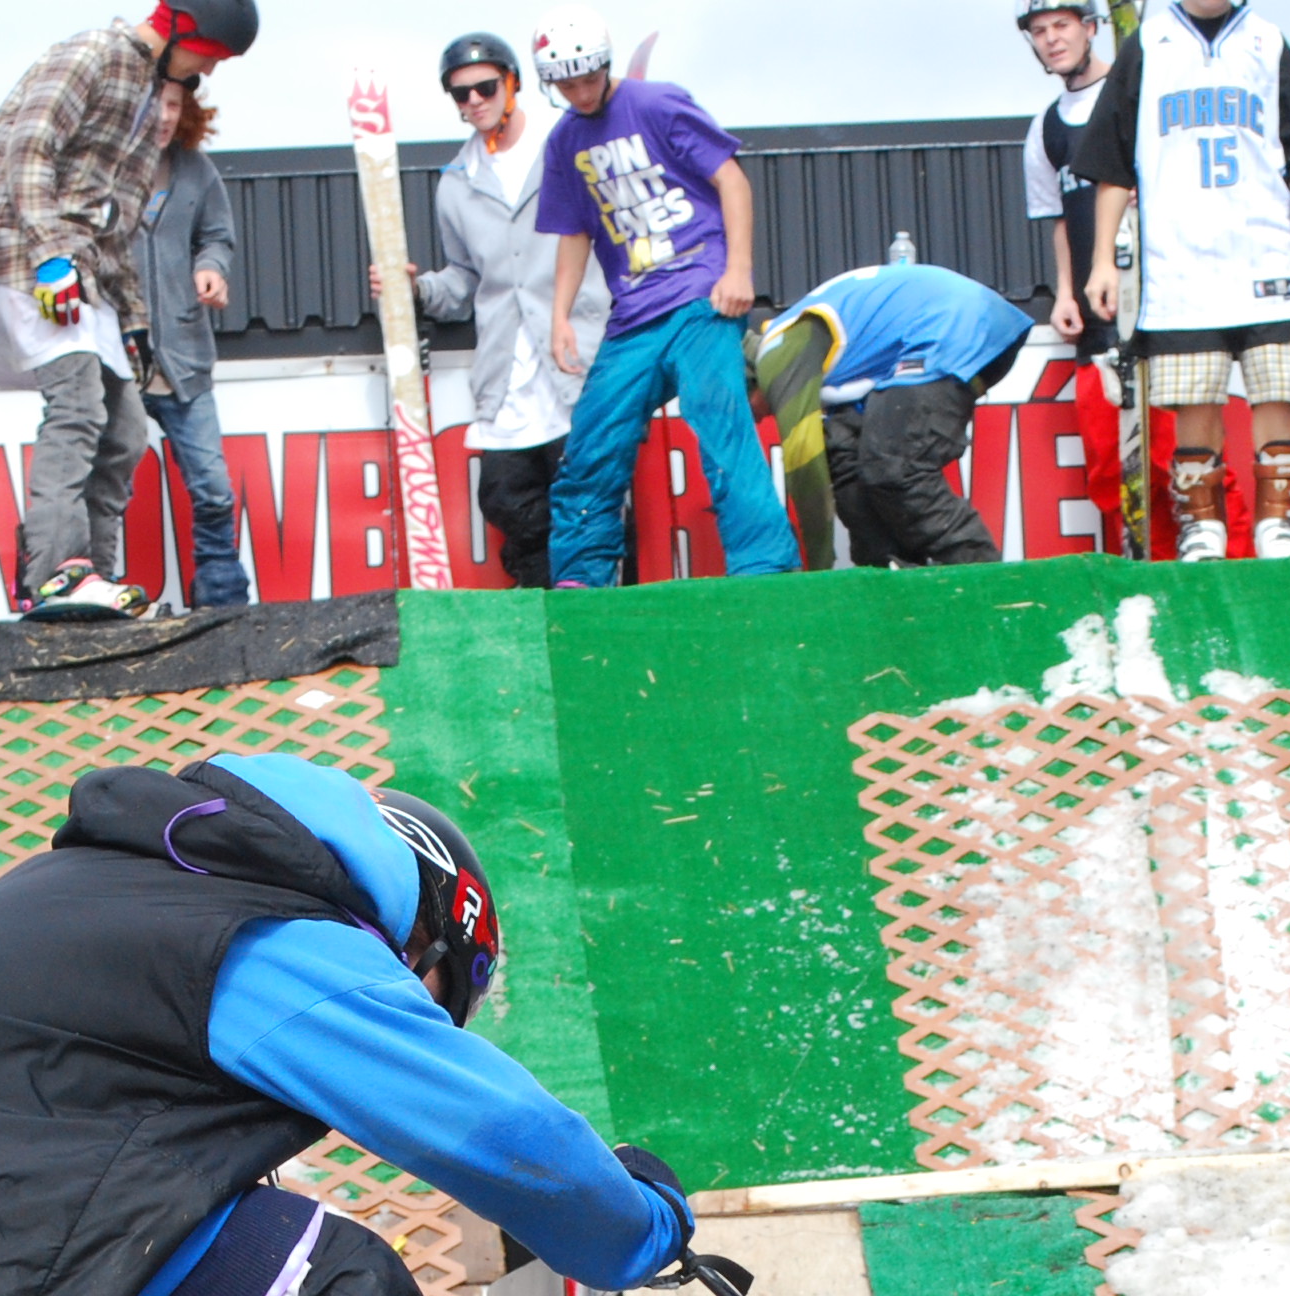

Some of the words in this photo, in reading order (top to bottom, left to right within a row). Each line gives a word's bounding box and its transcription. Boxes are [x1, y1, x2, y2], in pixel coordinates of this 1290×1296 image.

[1159, 86, 1265, 137] MAGIC
[575, 133, 651, 184] SPIN
[1197, 136, 1239, 189] 15
